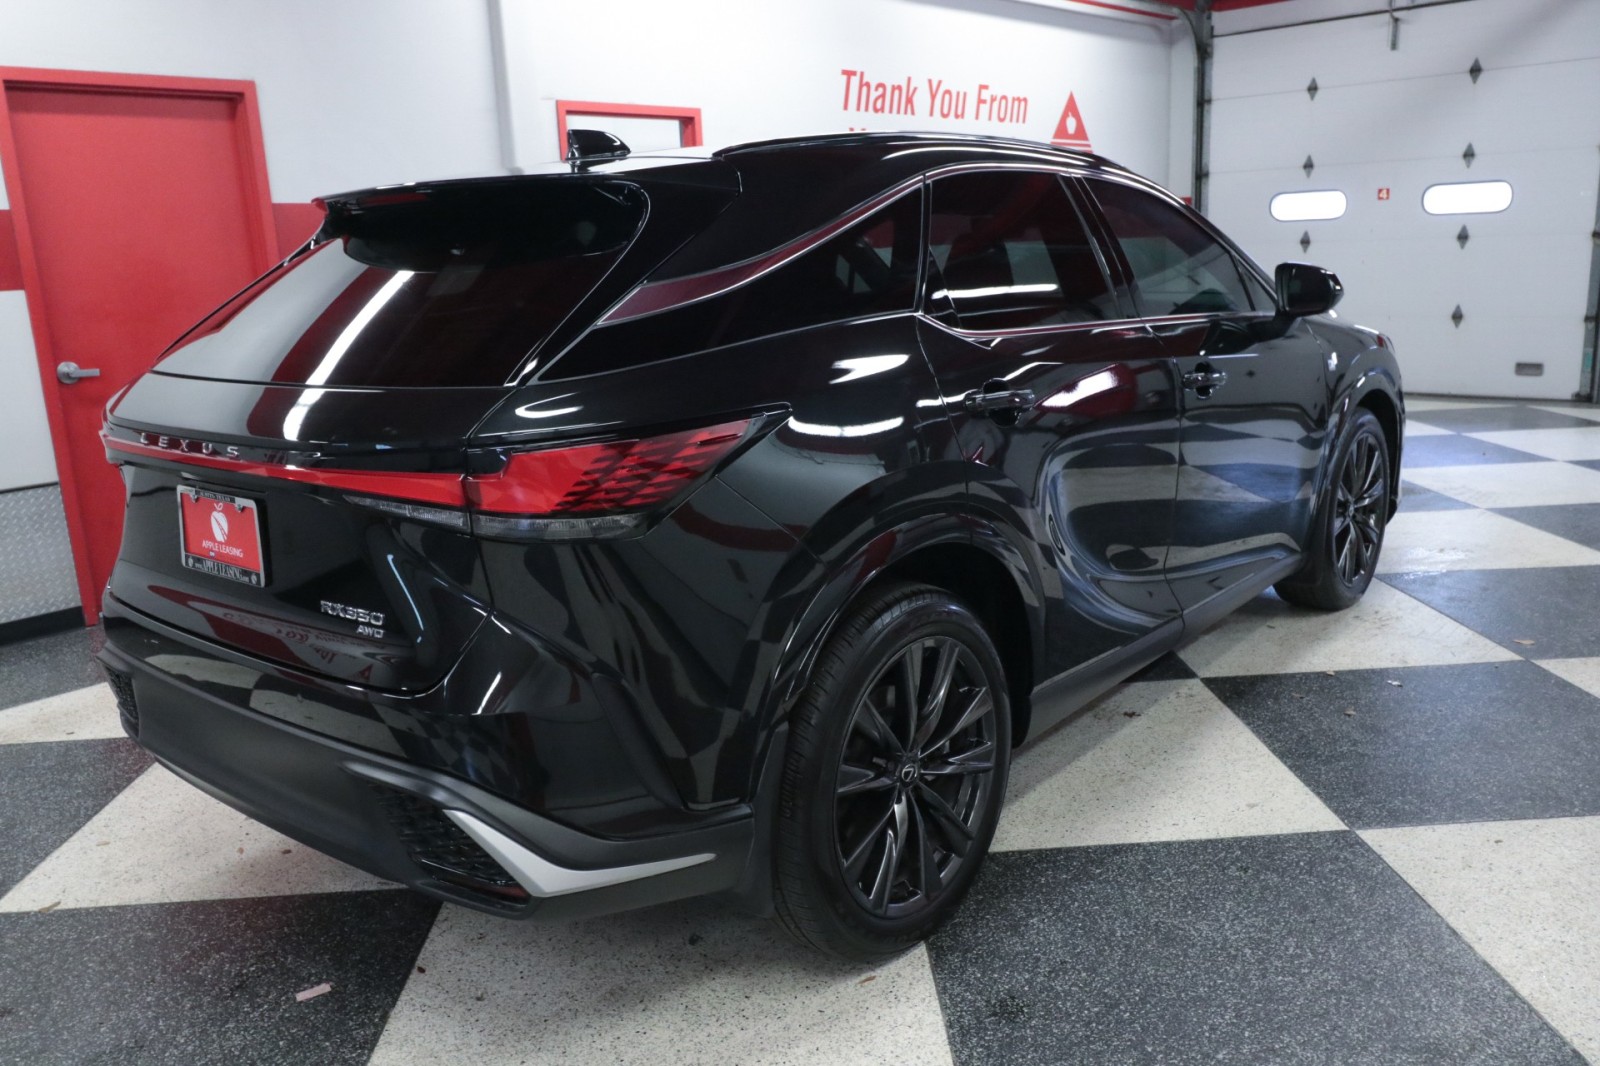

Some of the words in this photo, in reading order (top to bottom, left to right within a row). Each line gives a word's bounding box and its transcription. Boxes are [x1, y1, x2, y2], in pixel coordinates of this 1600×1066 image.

[841, 69, 918, 117] Thank
[927, 78, 967, 120] You
[974, 84, 1028, 124] From
[140, 432, 239, 457] LEXUS
[202, 539, 219, 552] APPLE
[219, 543, 243, 558] LEASING
[357, 625, 384, 638] AWD
